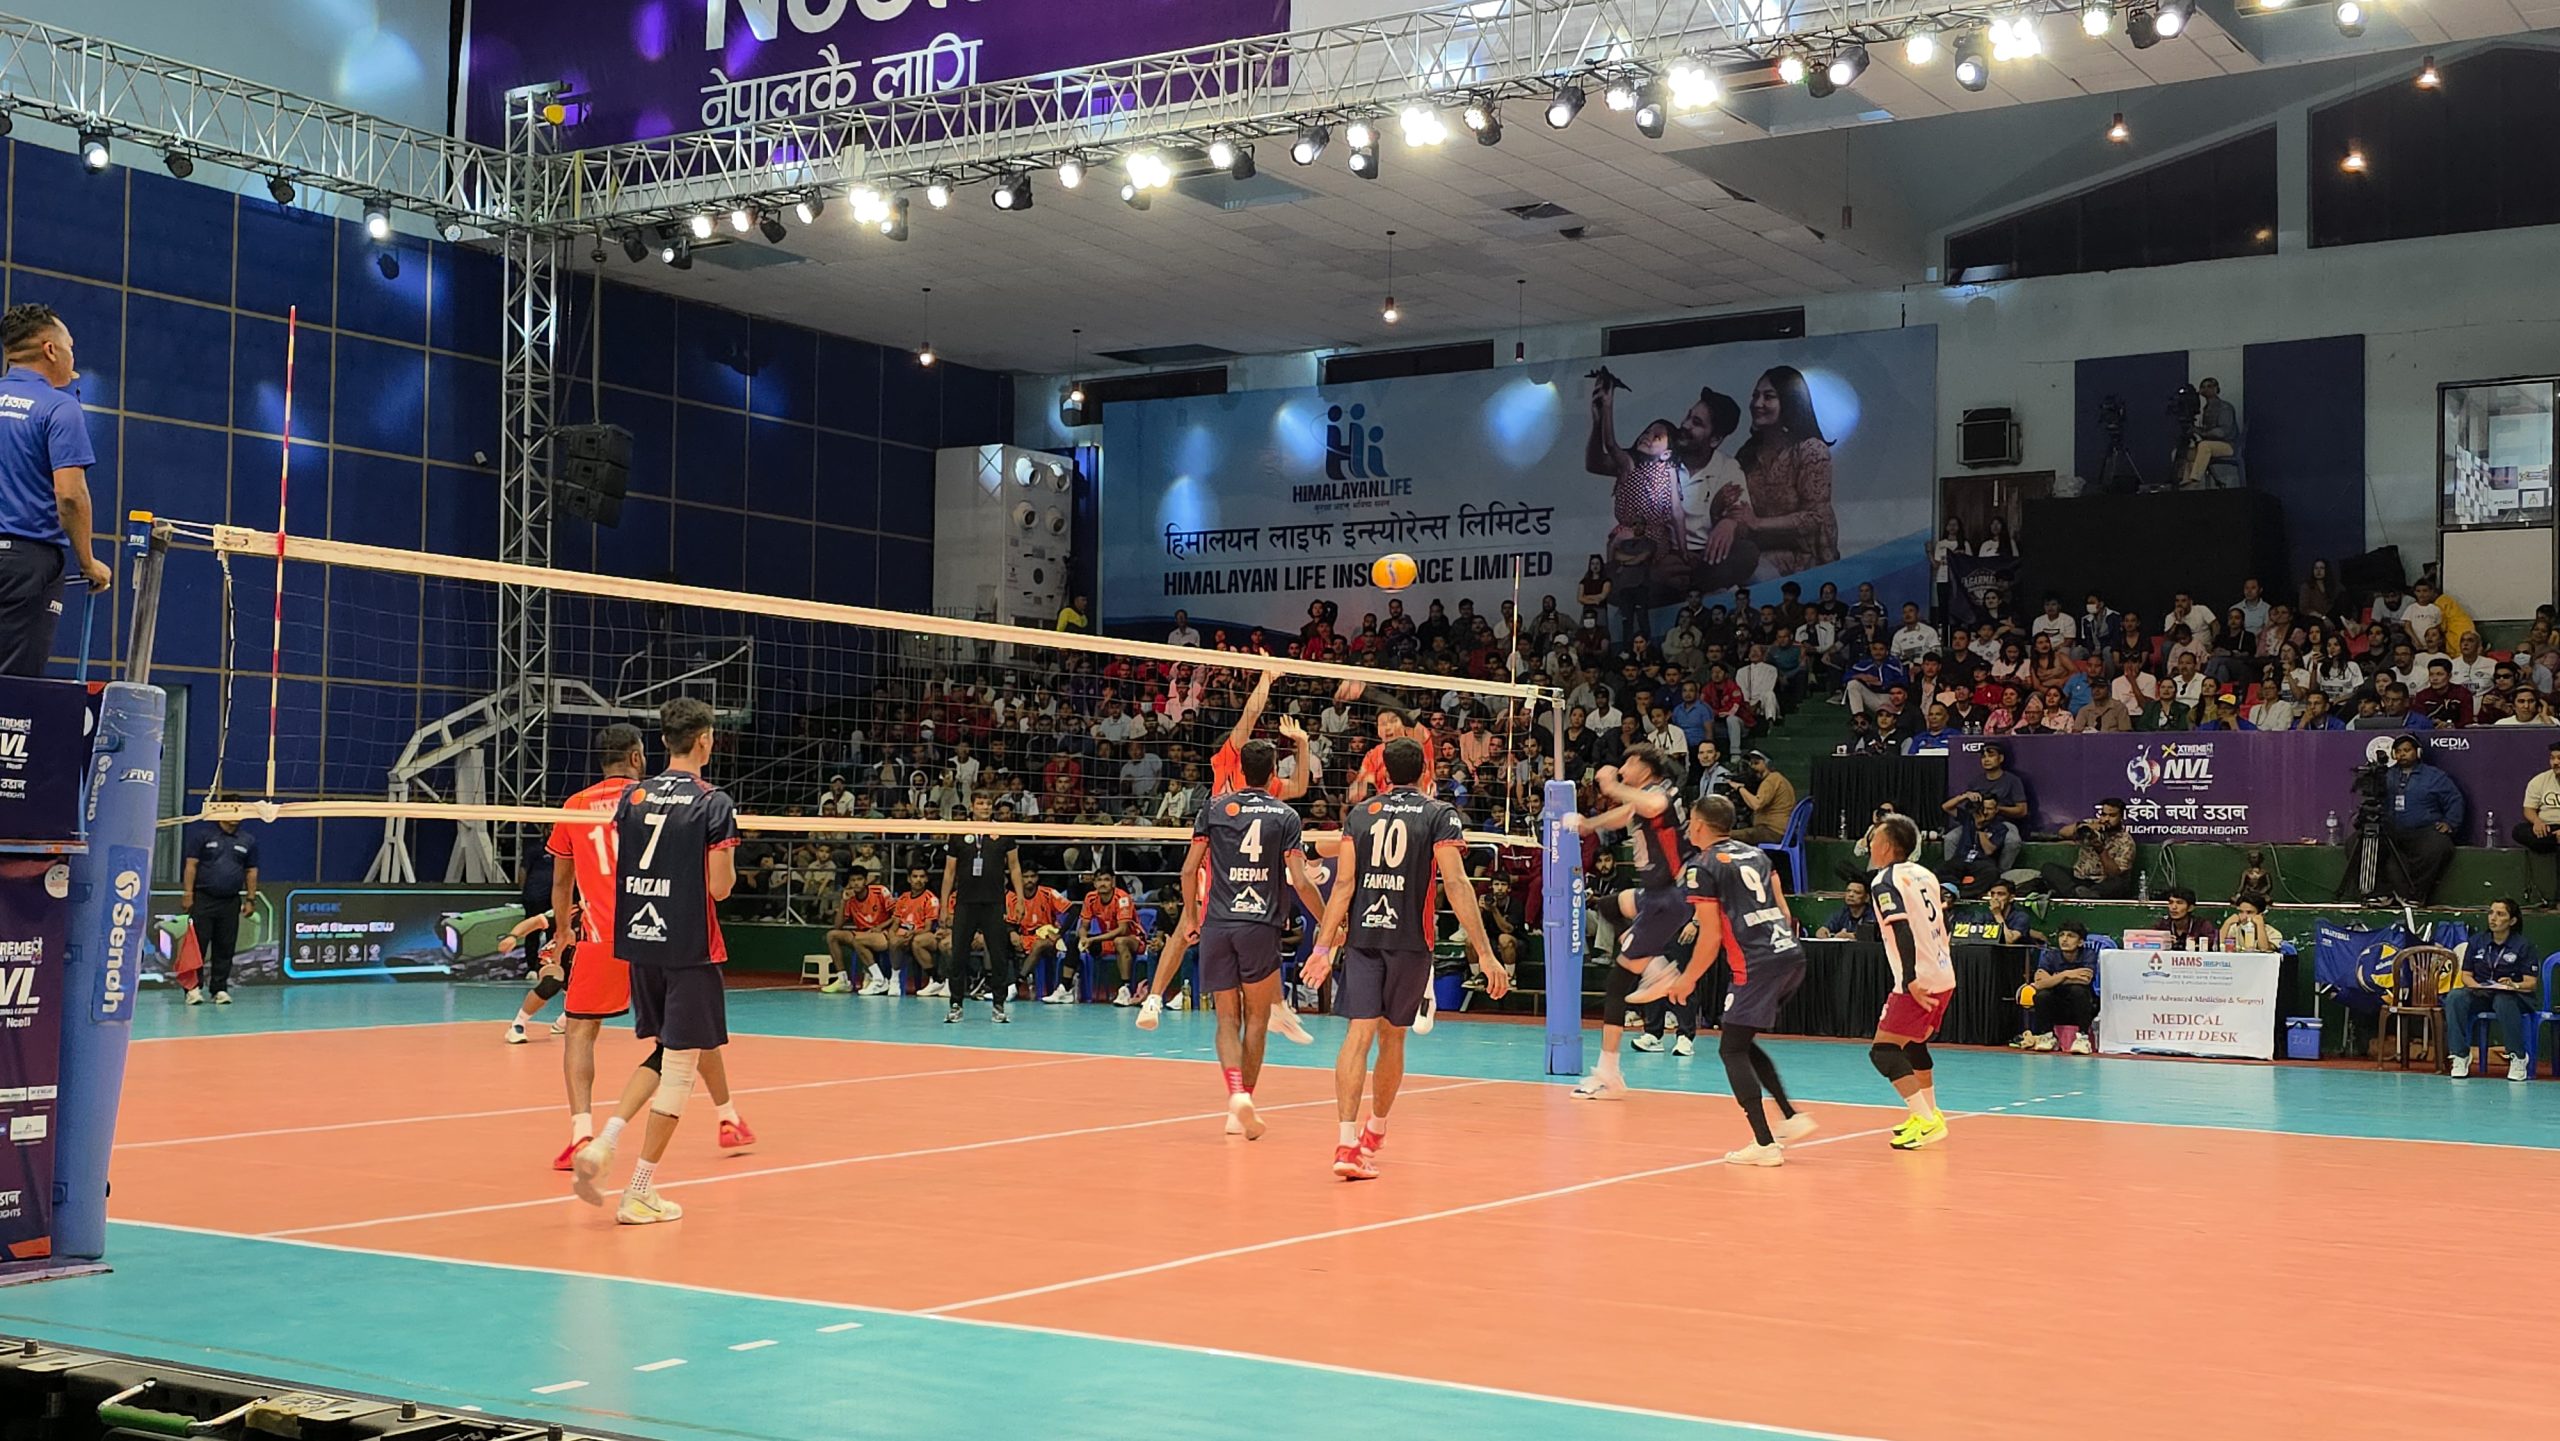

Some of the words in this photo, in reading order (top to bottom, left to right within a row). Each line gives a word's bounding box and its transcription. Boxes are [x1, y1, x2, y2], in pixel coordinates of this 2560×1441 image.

[701, 44, 862, 127] नेपालकै
[872, 32, 983, 101] लागि
[1165, 523, 1260, 560] हिमालयन
[1269, 523, 1333, 552] लाइफ
[1342, 511, 1450, 549] इन्स्योरेन्स
[1458, 501, 1554, 538] लिमिटेड
[1164, 568, 1278, 596] HIMALAYAN
[1285, 565, 1326, 590] LIFE
[1333, 558, 1453, 589] INSNCE
[1460, 551, 1552, 581] LIMITED
[2430, 738, 2469, 748] KEDIA
[2163, 758, 2213, 779] NVL
[2165, 798, 2198, 820] नयाँ
[2202, 804, 2248, 820] उडान
[644, 813, 668, 869] 7
[1240, 819, 1262, 862] 4
[2170, 826, 2208, 834] GREATER
[2209, 826, 2248, 834] HEIGHTS
[1370, 819, 1407, 868] 10
[1229, 867, 1269, 881] DEEPAK
[1363, 873, 1405, 891] FAKHAR
[1740, 865, 1767, 903] 9
[626, 876, 670, 897] FAIZAN
[1920, 888, 1936, 922] 5
[102, 902, 134, 1012] Senoh
[2171, 956, 2202, 967] HAMS
[2152, 1013, 2223, 1026] MEDICAL
[2136, 1029, 2194, 1041] HEALTH
[2199, 1031, 2238, 1043] DESK
